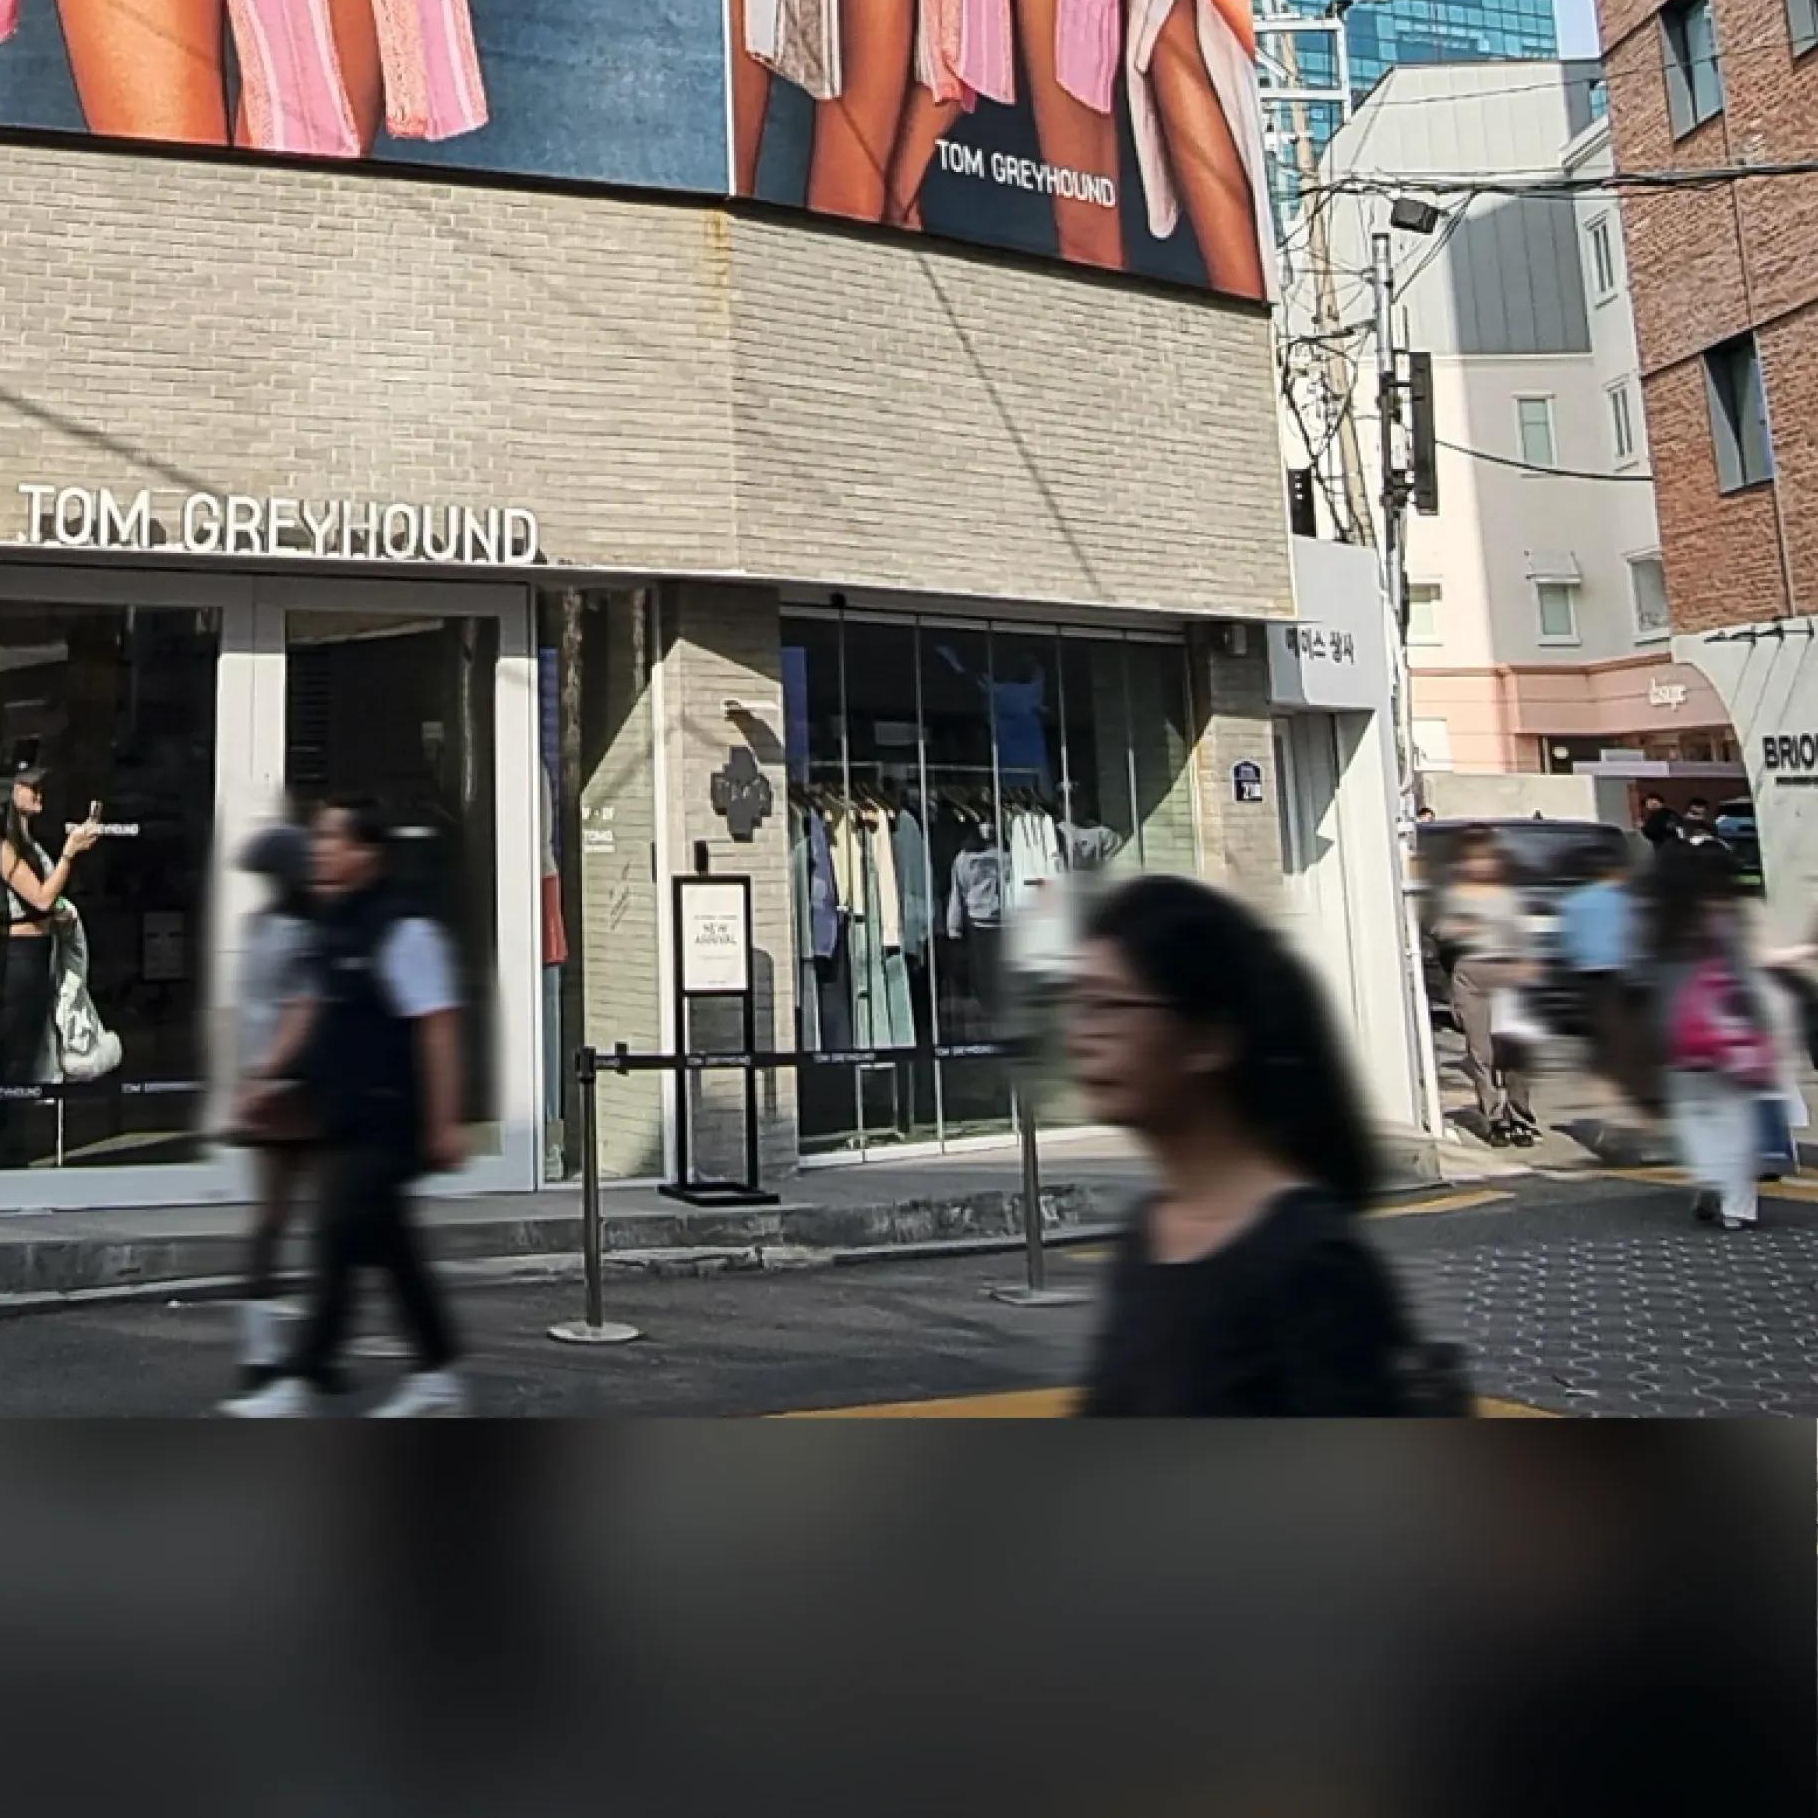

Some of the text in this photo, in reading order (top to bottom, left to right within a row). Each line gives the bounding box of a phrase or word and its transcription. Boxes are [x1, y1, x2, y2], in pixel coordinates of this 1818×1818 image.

[935, 138, 1116, 208] TOM GREYHOUND
[18, 484, 540, 565] TOM GREYHOUND
